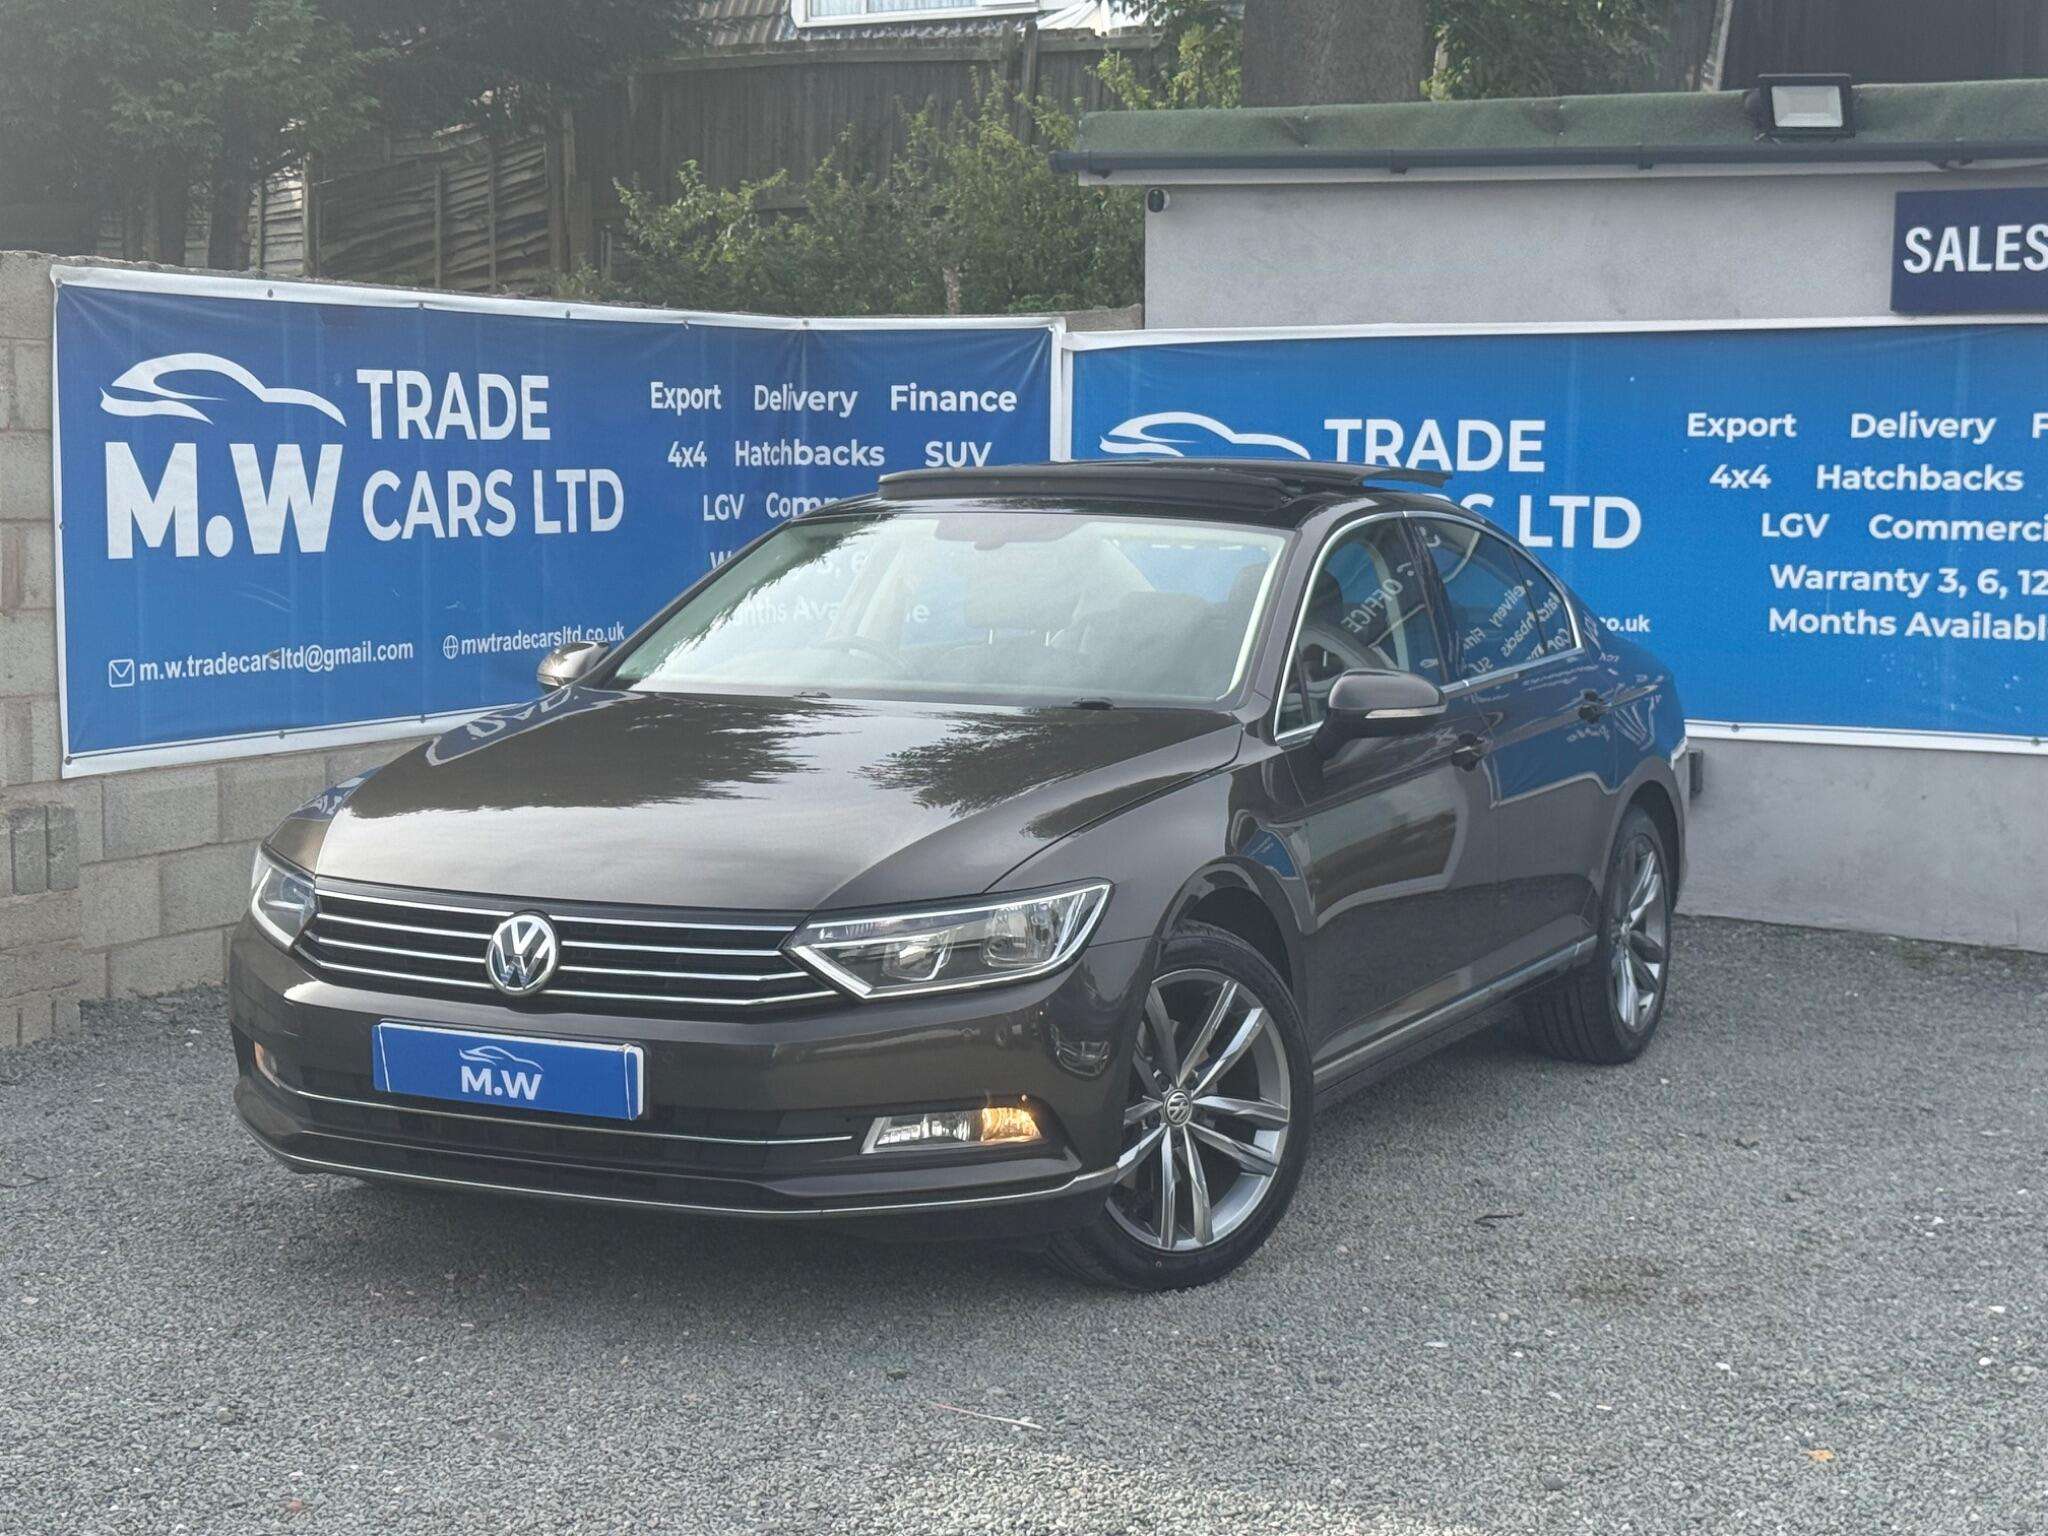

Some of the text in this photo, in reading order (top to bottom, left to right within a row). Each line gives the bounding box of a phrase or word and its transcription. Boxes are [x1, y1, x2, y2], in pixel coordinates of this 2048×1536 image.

[1902, 223, 2048, 274] SALES
[357, 368, 551, 440] TRADE
[650, 381, 1018, 417] Export Delivery Finance
[1324, 419, 1546, 472] TRADE
[1687, 412, 1798, 443] Export
[1850, 411, 1997, 445] Delivery
[668, 438, 992, 468] 4x4 Hatchbacks SUV
[1709, 464, 2024, 492] 4x4 Hatchbacks
[105, 442, 344, 559] M.W
[362, 468, 625, 542] CARS LTD
[703, 493, 745, 522] LGV
[1518, 495, 1643, 549] LTD
[1761, 513, 1830, 539] LGV
[1769, 563, 1930, 598] Warranty
[1938, 567, 1968, 599] 3,
[1977, 568, 2009, 600] 6,
[1768, 608, 1897, 636] Months
[139, 640, 414, 682] m.w.tradecarsltd@gmail.com
[460, 1065, 542, 1100] M.W
